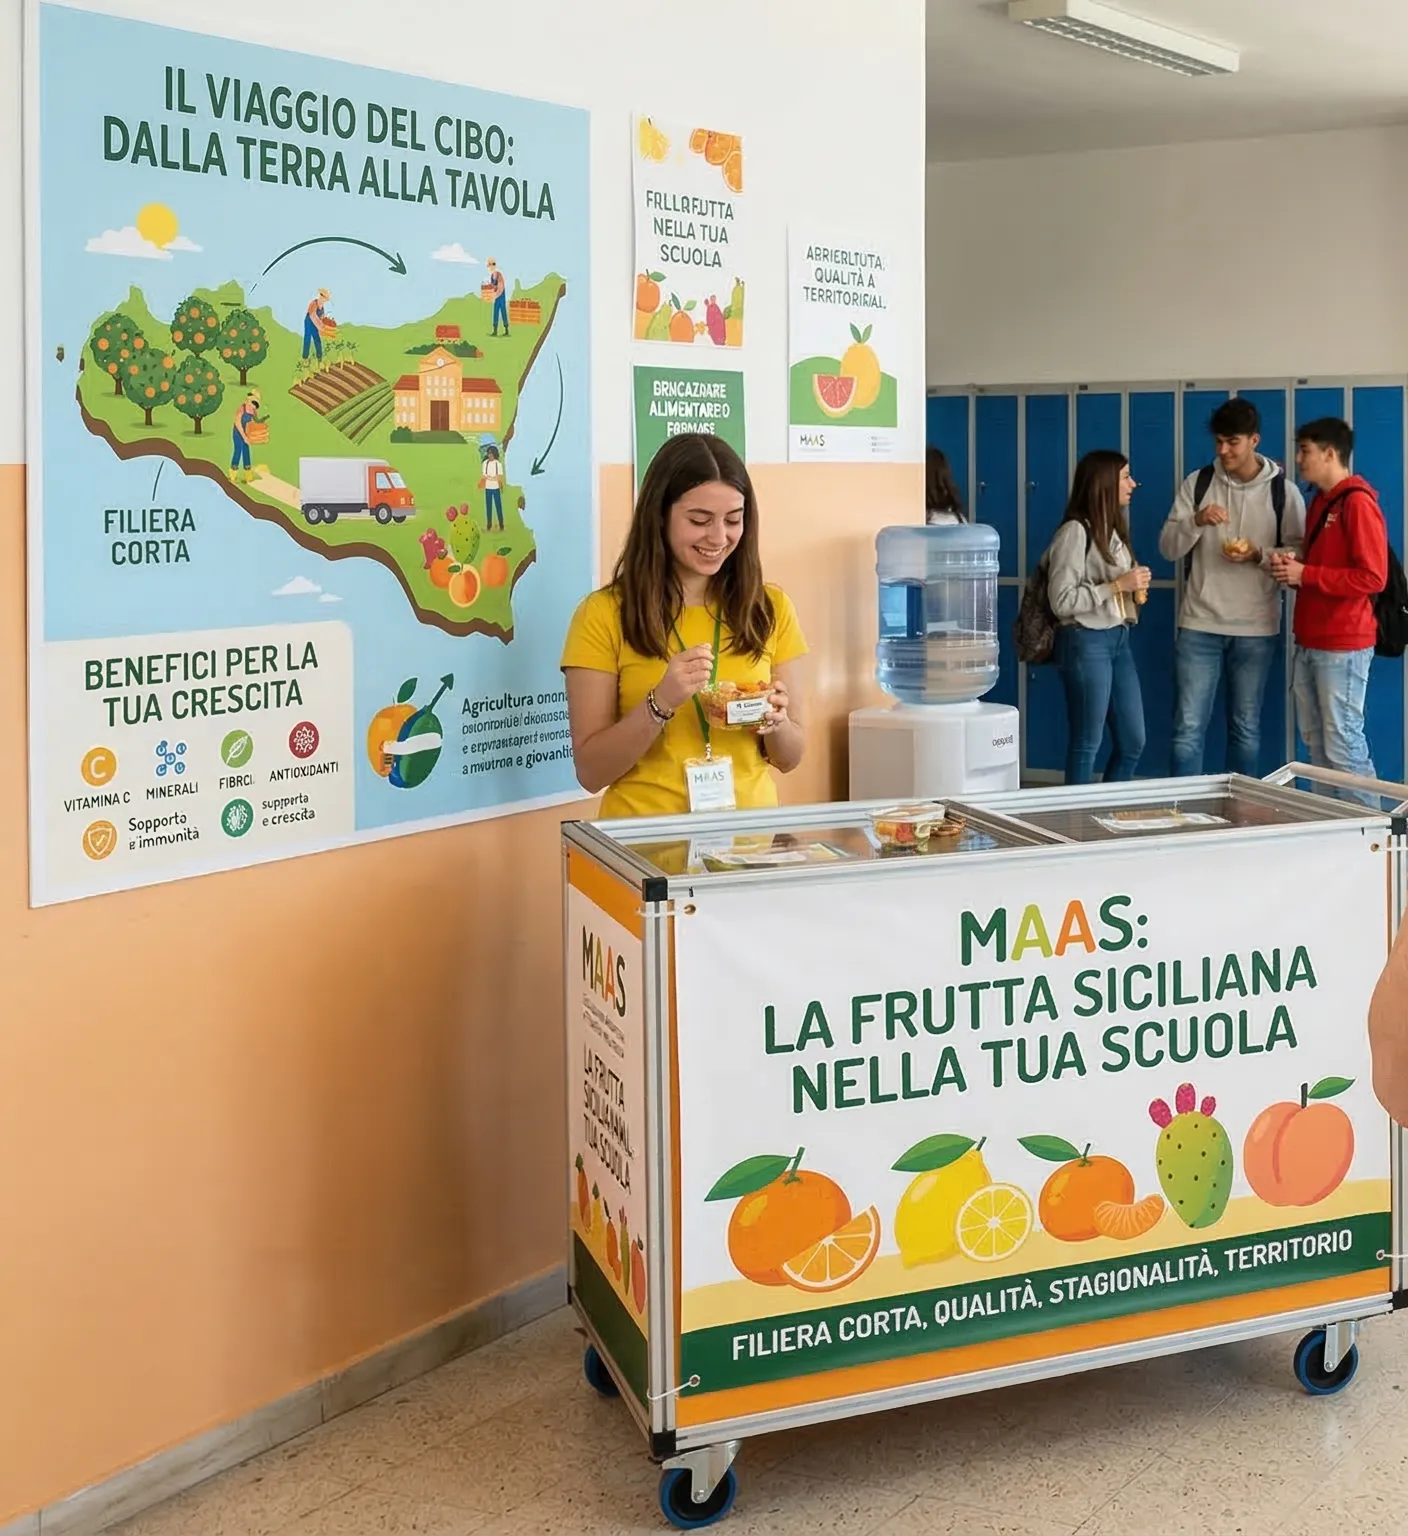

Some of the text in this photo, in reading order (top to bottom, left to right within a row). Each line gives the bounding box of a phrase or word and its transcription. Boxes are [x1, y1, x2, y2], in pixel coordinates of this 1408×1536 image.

[165, 66, 514, 166] IL VIAGGIO DEL CIBO:
[103, 115, 555, 221] DALLA TERRA ALLA TAVOLA
[654, 217, 728, 244] NELLA TUA
[660, 243, 722, 268] SCUOLA
[814, 267, 876, 289] QUALITÀ A
[104, 507, 196, 534] FILIERA
[111, 538, 190, 565] CORTA
[85, 641, 318, 690] BENEFICI PER LA
[102, 679, 303, 727] TUA CRESCITA
[461, 692, 534, 719] Agricultura
[64, 791, 131, 812] VITAMINA C
[146, 782, 199, 800] MINERALI
[262, 817, 269, 826] e
[960, 895, 1149, 967] MAAS:
[582, 925, 626, 1018] MAAS
[763, 944, 1318, 1056] LA FRUTTA SICILIANA
[791, 1005, 1298, 1114] NELLA TUA SCUOLA
[731, 1229, 1353, 1361] FILIERA CORTA, QUALITÀ, STAGIONALITÀ, TERRITORIO
